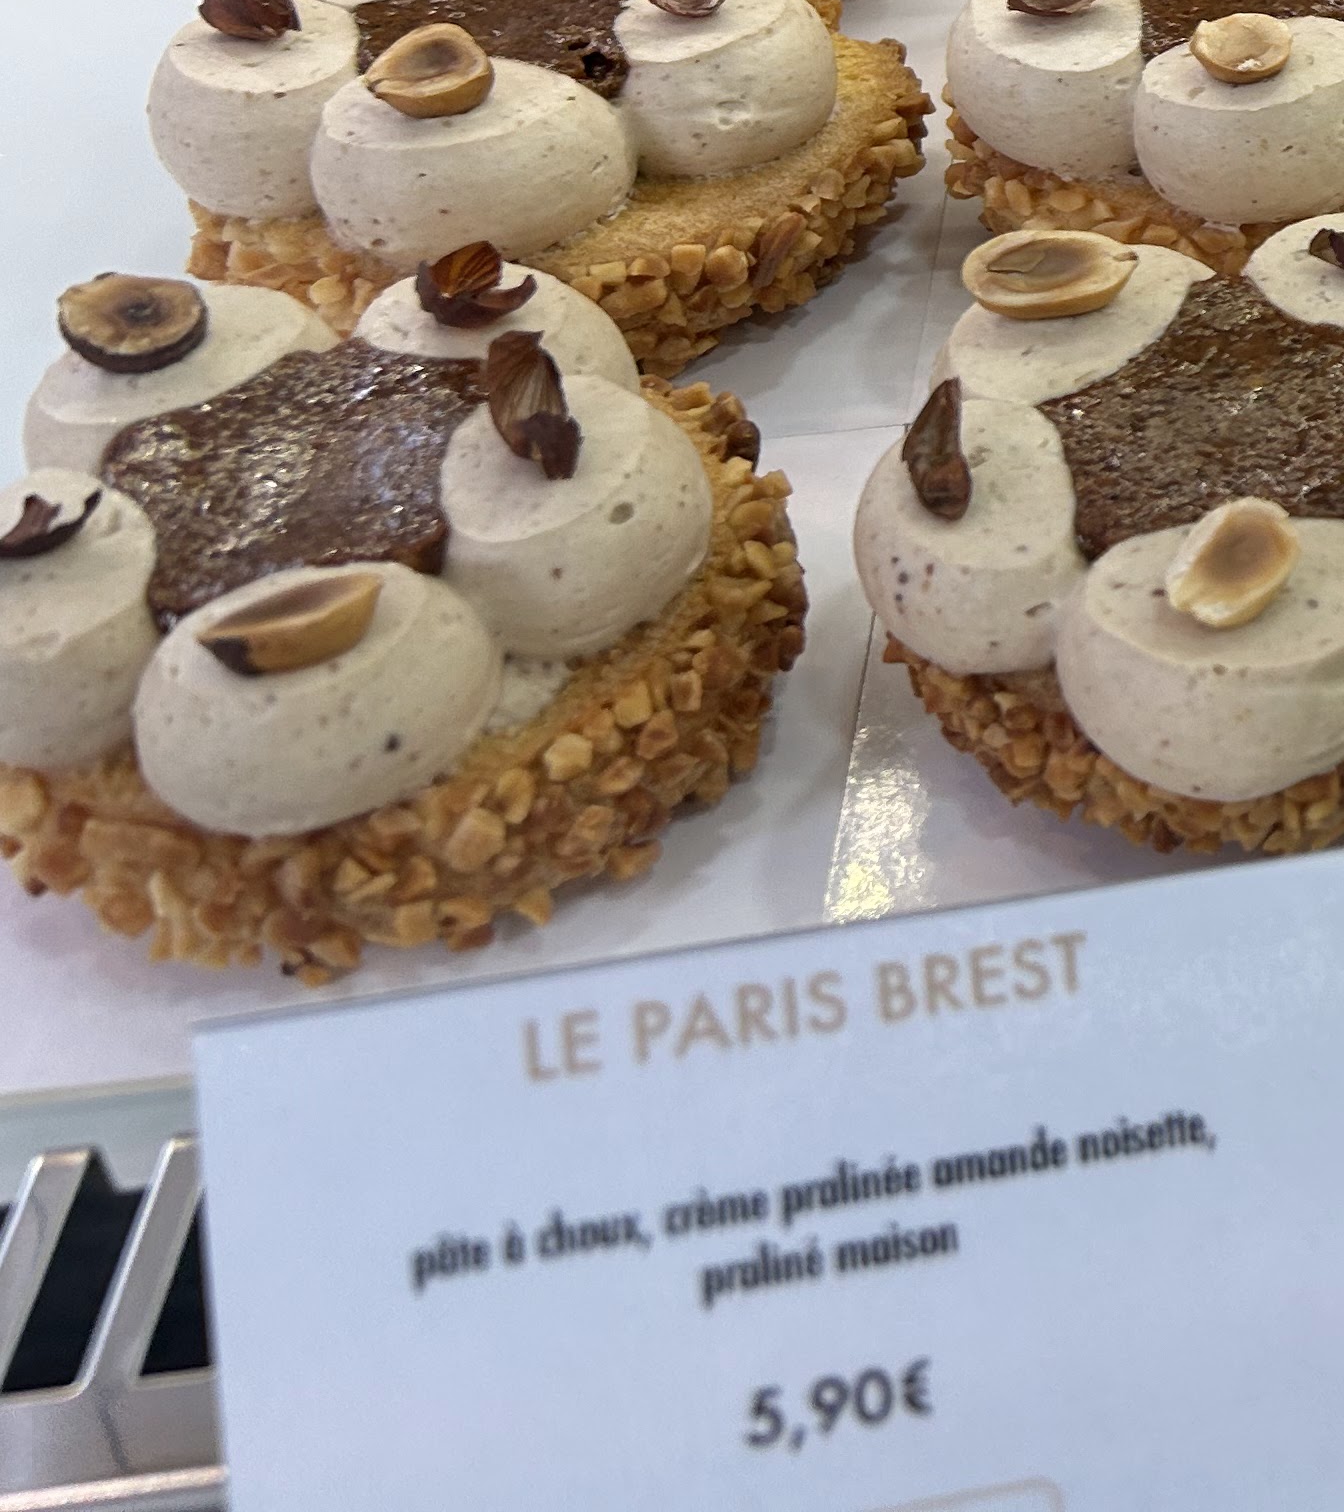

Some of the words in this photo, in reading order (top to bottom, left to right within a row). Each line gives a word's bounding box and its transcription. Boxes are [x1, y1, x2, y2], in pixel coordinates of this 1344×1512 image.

[522, 1009, 600, 1082] LE
[630, 970, 849, 1067] PARIS
[877, 932, 1086, 1024] BREST
[412, 1231, 490, 1293] pâte
[536, 1206, 654, 1261] choux,
[663, 1185, 770, 1237] crème
[780, 1156, 921, 1229] pralinée
[933, 1124, 1068, 1190] amande
[1077, 1110, 1217, 1164] noisette,
[700, 1236, 824, 1311] praliné
[835, 1221, 960, 1275] maison
[744, 1356, 933, 1453] 5,90€
